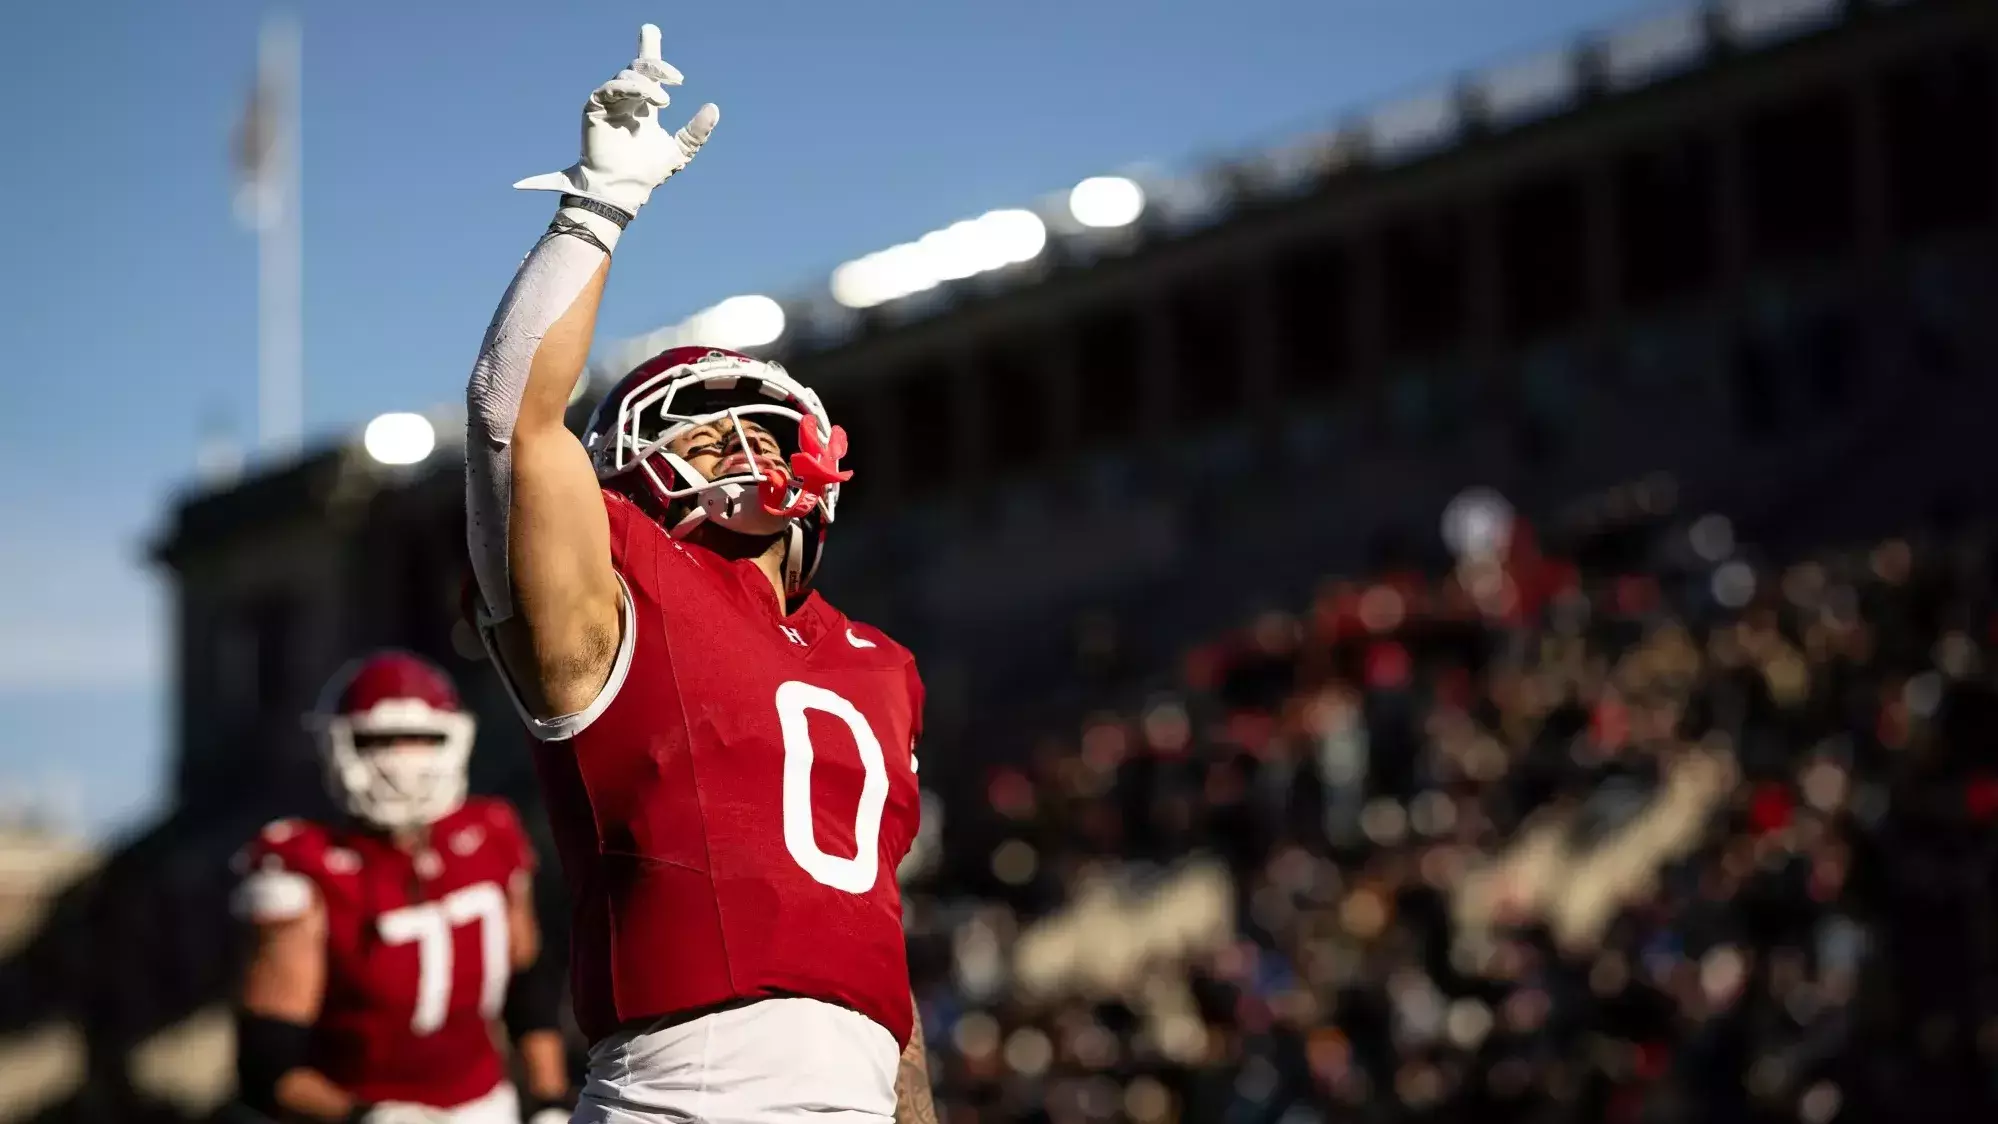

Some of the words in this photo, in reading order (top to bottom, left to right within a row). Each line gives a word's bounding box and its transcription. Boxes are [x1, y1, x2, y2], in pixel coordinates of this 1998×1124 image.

[779, 625, 808, 646] H
[776, 680, 889, 894] 0
[378, 881, 511, 1034] 77
